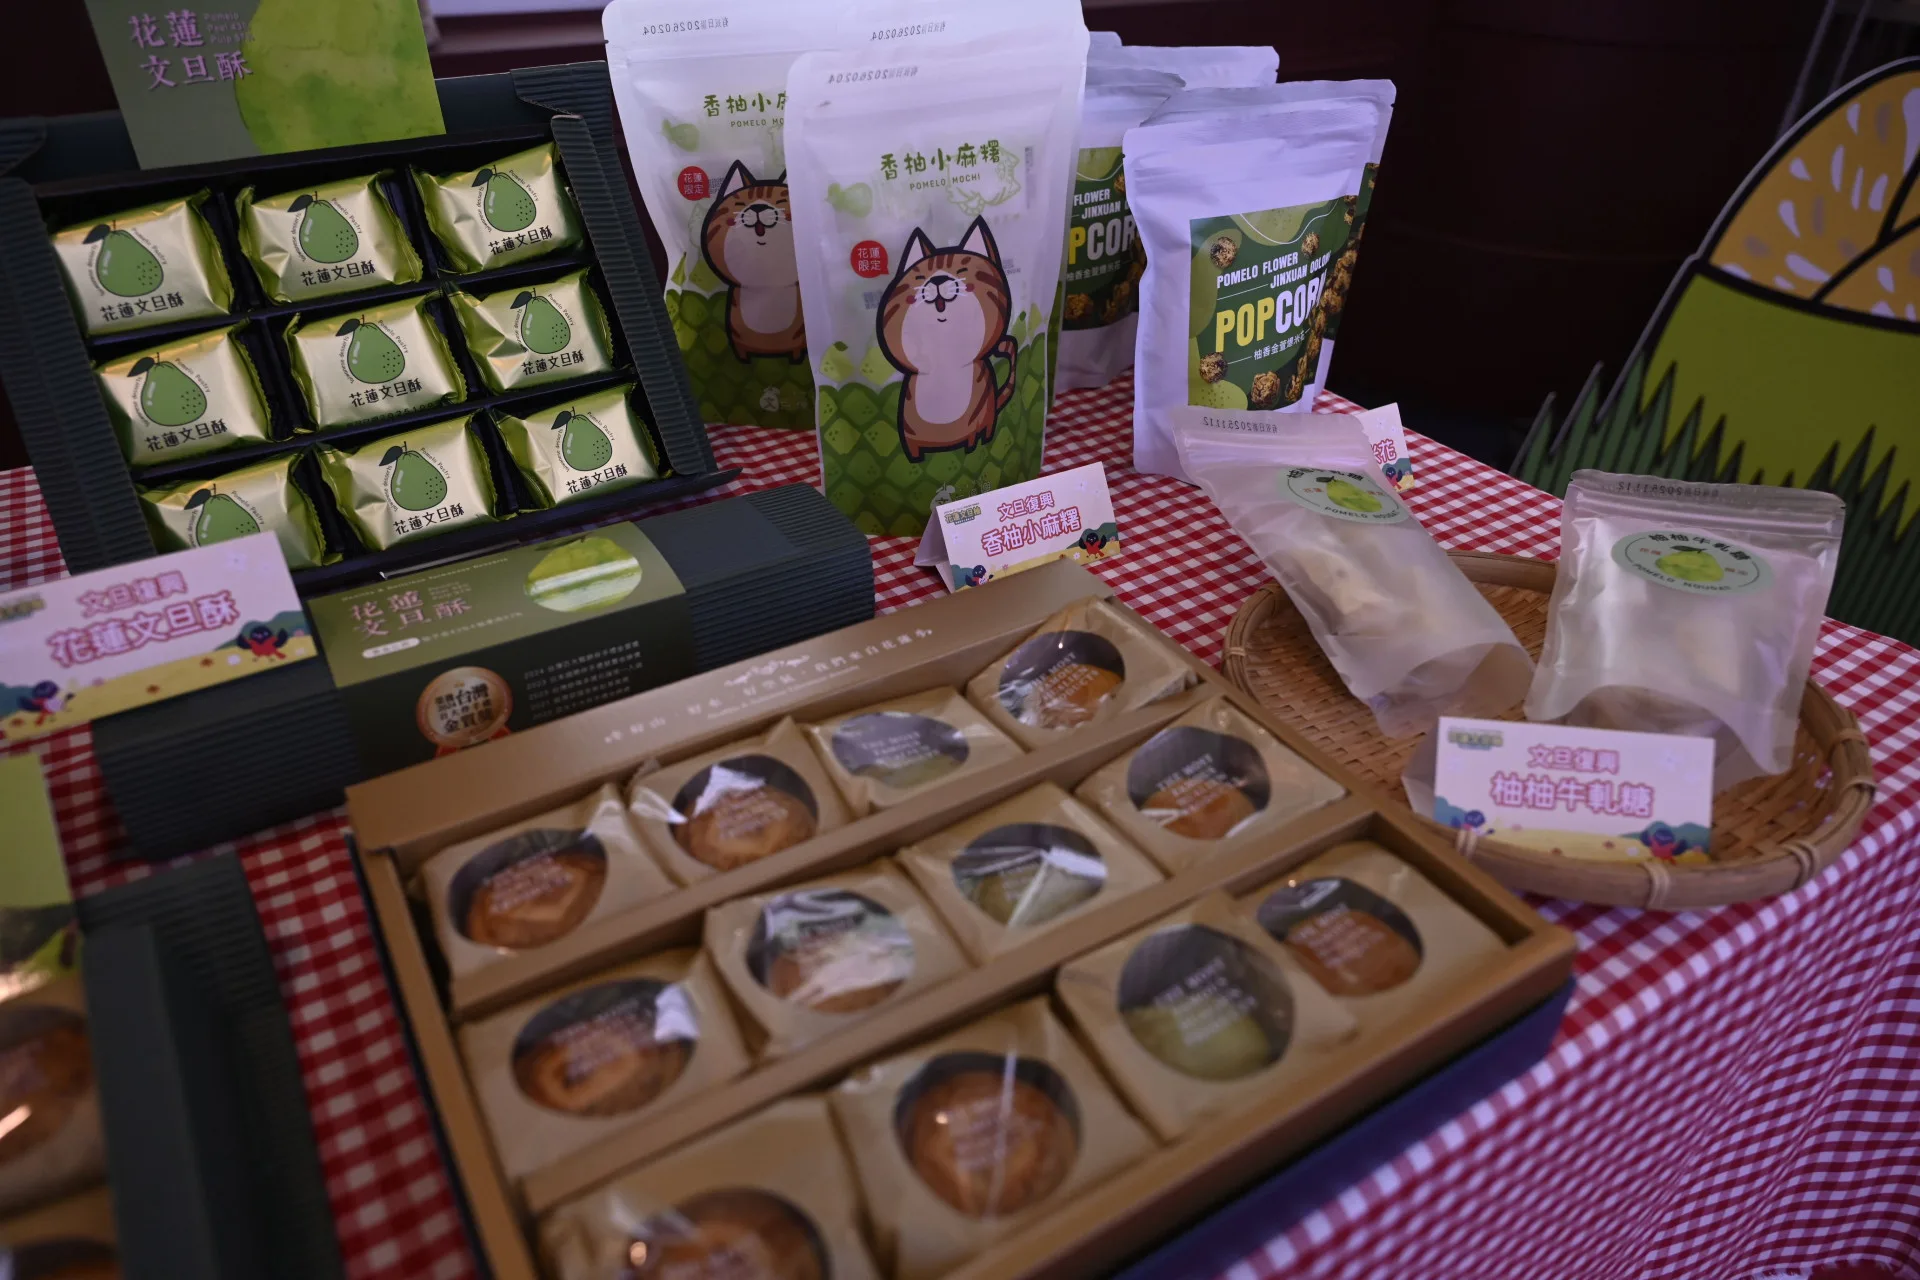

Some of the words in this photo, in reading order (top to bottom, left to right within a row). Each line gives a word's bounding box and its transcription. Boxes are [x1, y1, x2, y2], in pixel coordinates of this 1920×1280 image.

[128, 9, 204, 48] 花蓮
[140, 50, 253, 90] 文旦酥
[730, 119, 767, 128] POMELO
[880, 139, 1000, 180] 香柚小麻糬
[683, 172, 703, 184] 花蓮
[684, 184, 703, 195] 限定
[909, 178, 946, 190] POMELO
[952, 172, 981, 185] MOCHI
[526, 183, 540, 202] Pastry
[1073, 188, 1110, 207] FLOWER
[1081, 201, 1121, 220] JINXUAN
[349, 215, 363, 234] Pastry
[488, 225, 553, 256] 花蓮文旦酥
[857, 247, 881, 260] 花蓮
[300, 260, 376, 286] 花蓮文旦酥
[858, 259, 882, 272] 限定
[1216, 265, 1259, 289] POMELO
[1262, 251, 1299, 275] FLOWER
[1270, 263, 1308, 289] JINXUAN
[100, 292, 184, 322] 花蓮文旦酥
[562, 308, 575, 326] Pastry
[395, 335, 409, 354] Pastry
[521, 350, 584, 376] 花蓮文旦酥
[349, 378, 422, 407] 花蓮文旦酥
[144, 418, 228, 452] 花蓮文旦酥
[437, 462, 452, 479] Pastry
[566, 463, 628, 494] 花蓮文旦酥
[393, 502, 465, 535] 花蓮文旦酥
[998, 491, 1054, 521] 文旦復興
[981, 506, 1082, 557] 香柚小麻糬
[1632, 563, 1676, 583] POMELO
[350, 590, 424, 621] 花蓮
[47, 589, 240, 668] 花蓮文旦酥
[1048, 652, 1076, 673] MOST
[1490, 771, 1654, 819] 柚柚牛軋糖
